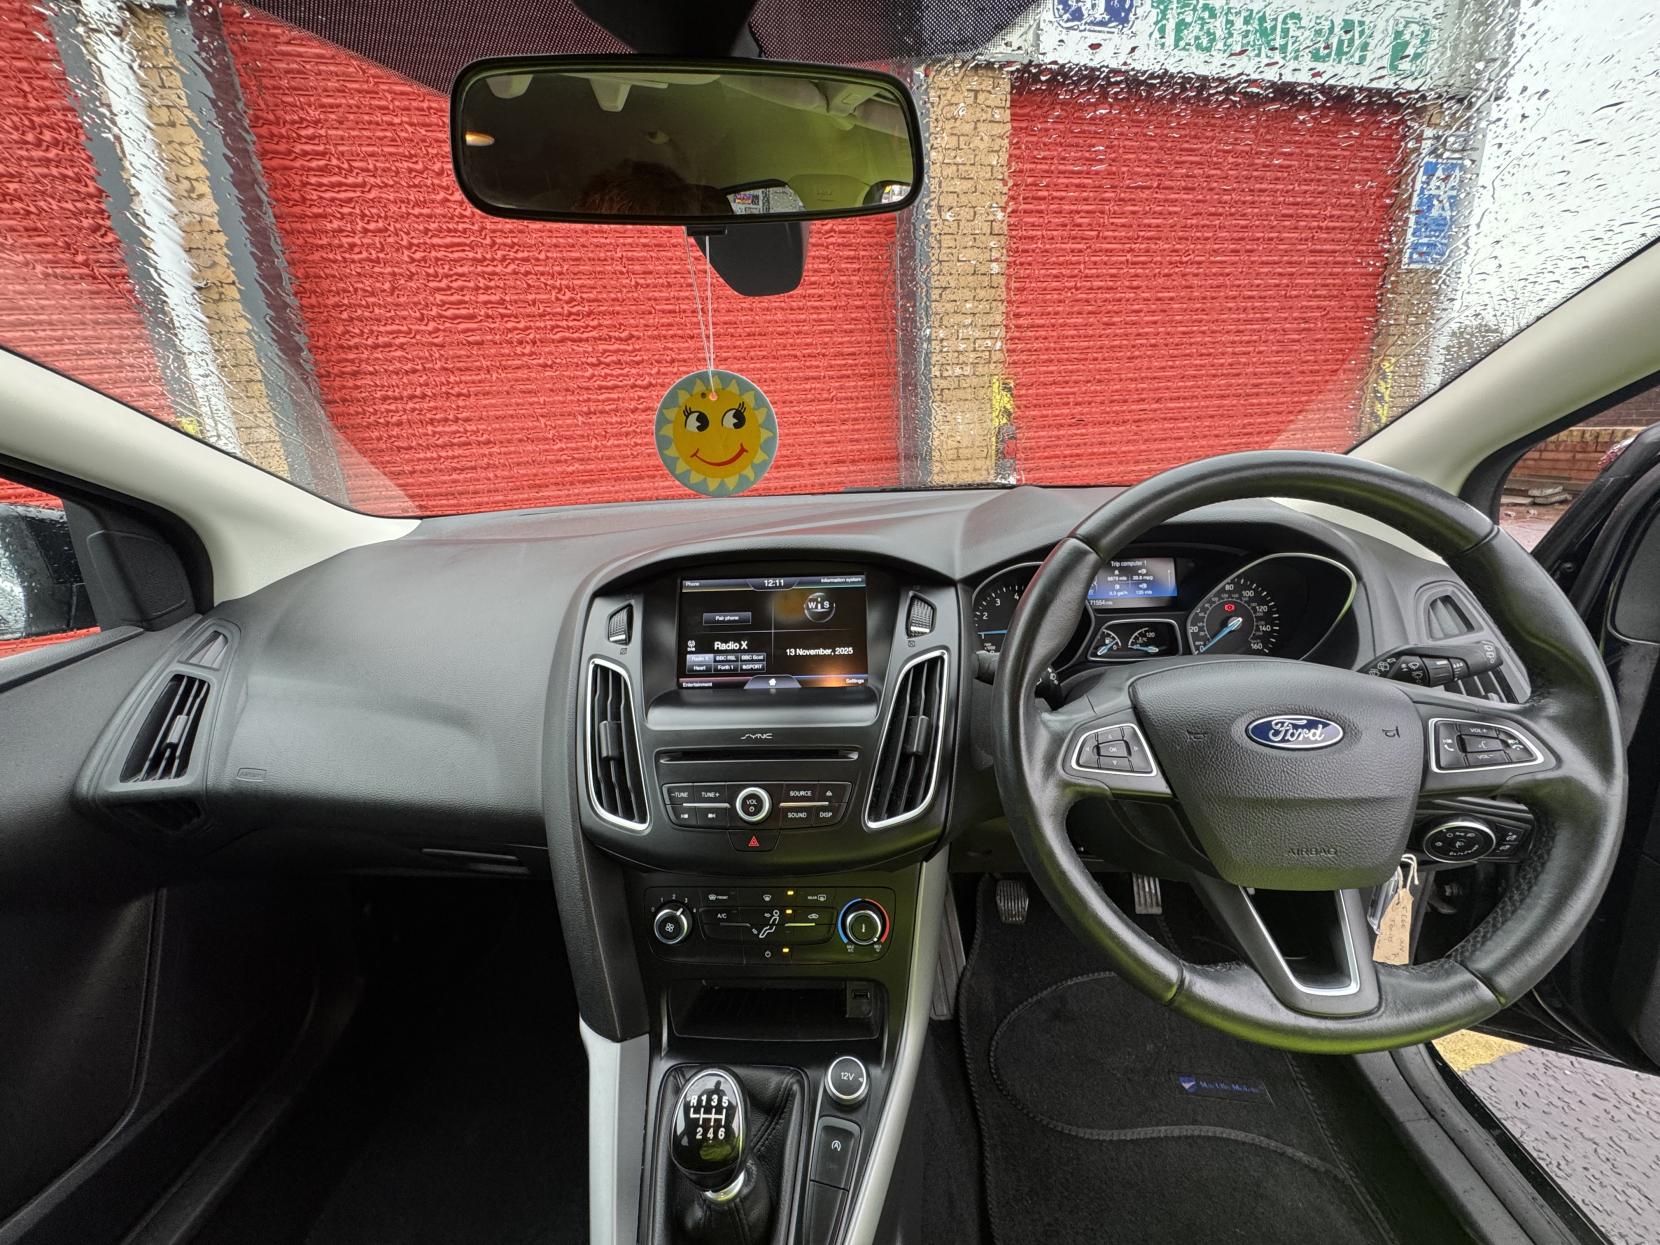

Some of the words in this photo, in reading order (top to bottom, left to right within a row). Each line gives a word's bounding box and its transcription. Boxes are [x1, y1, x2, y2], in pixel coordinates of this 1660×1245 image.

[764, 579, 784, 587] 12:11
[1014, 592, 1020, 600] 4
[995, 598, 1001, 607] 3
[982, 612, 989, 620] 2
[714, 641, 740, 650] Radio
[741, 640, 748, 649] X
[786, 648, 796, 656] 13
[796, 648, 834, 656] November,
[835, 647, 854, 655] 2025
[1268, 719, 1325, 741] Ford
[1288, 847, 1338, 857] AIRBAG
[841, 1072, 855, 1080] 12V
[690, 1095, 698, 1107] R
[701, 1094, 707, 1106] 1
[711, 1094, 719, 1106] 3
[721, 1095, 729, 1107] 5
[695, 1126, 703, 1139] 2
[707, 1127, 714, 1140] 4
[717, 1127, 726, 1140] 6
